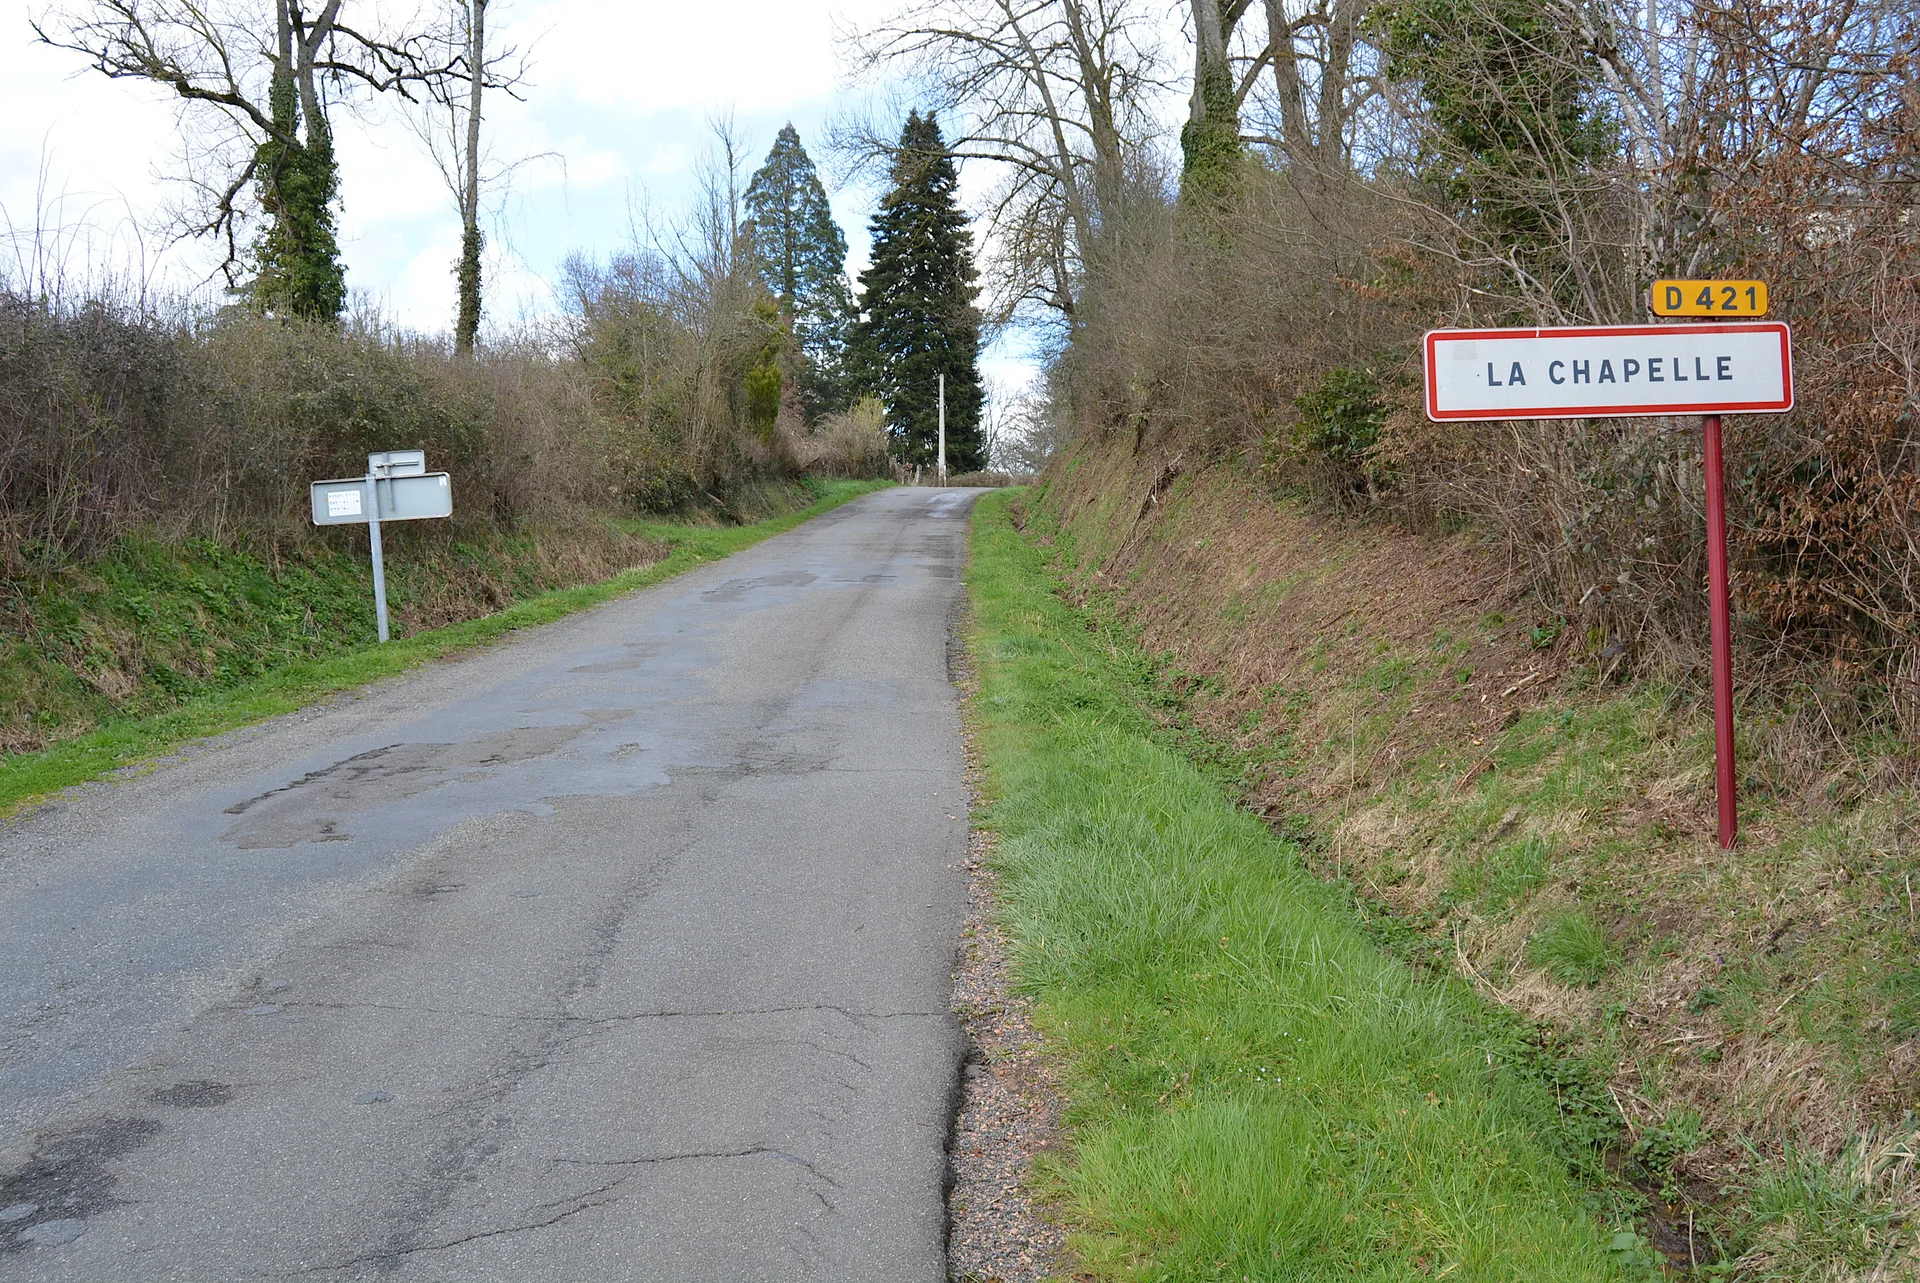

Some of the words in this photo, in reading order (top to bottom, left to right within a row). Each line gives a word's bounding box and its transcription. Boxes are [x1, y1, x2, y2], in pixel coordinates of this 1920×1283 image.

[1665, 286, 1683, 311] D
[1695, 286, 1757, 311] 421
[1487, 361, 1527, 387] LA
[1548, 355, 1734, 385] CHAPELLE
